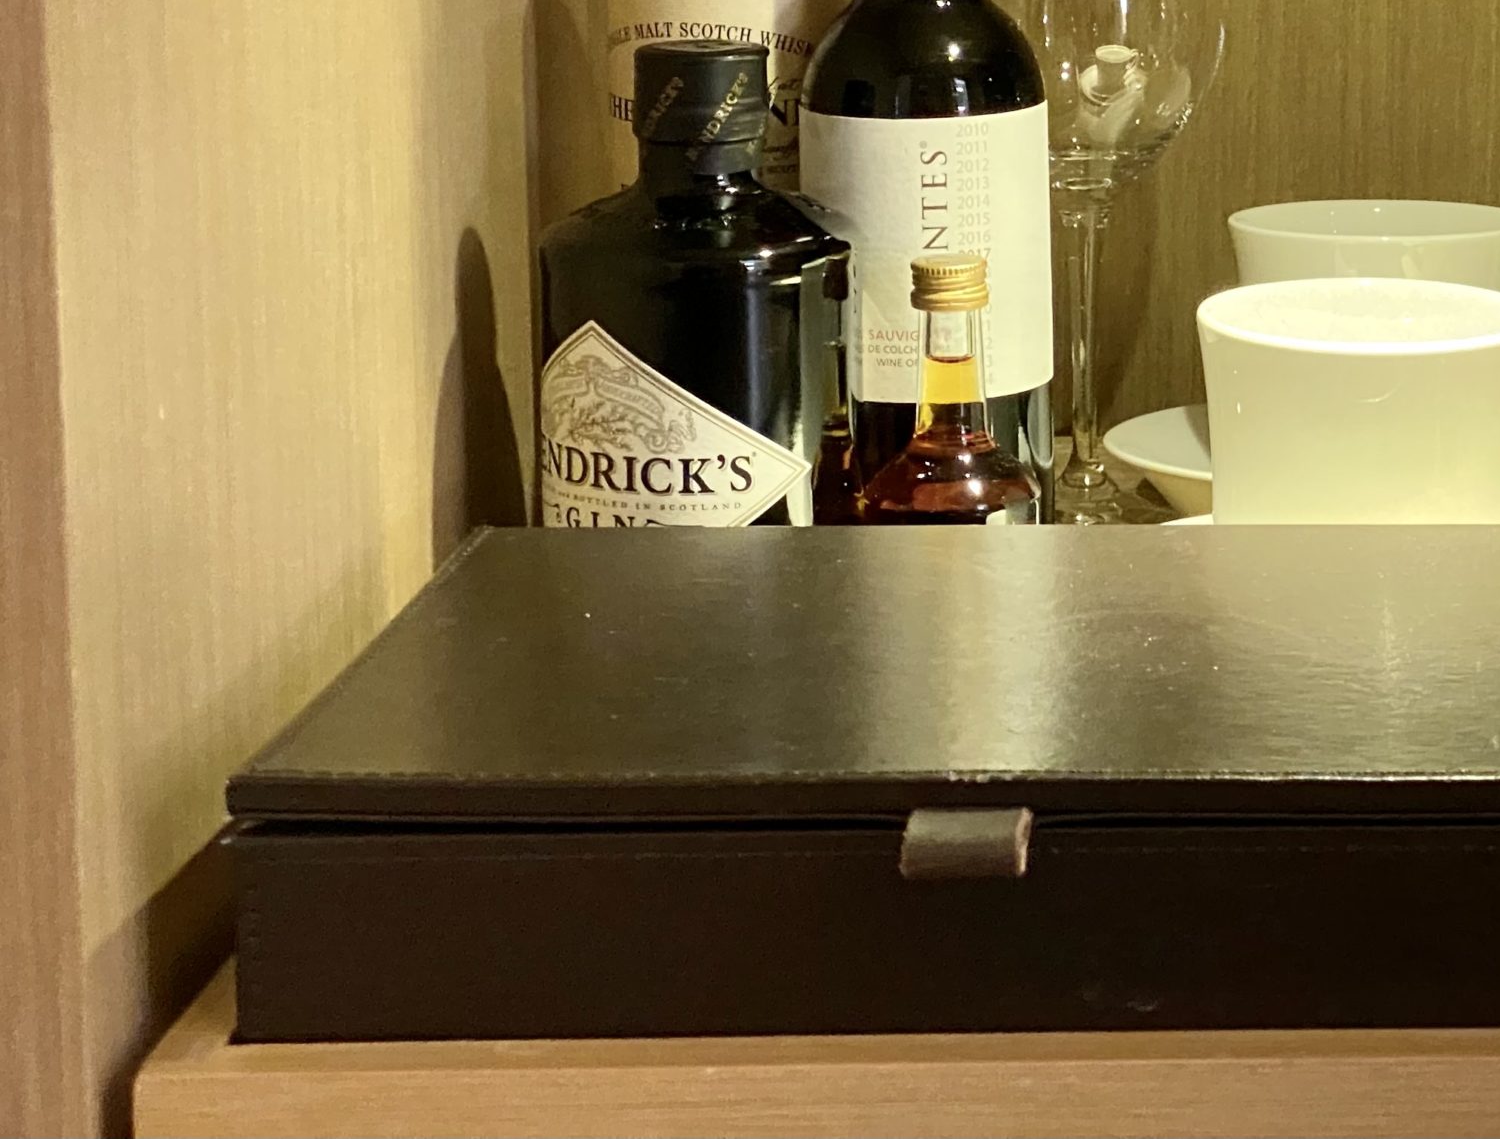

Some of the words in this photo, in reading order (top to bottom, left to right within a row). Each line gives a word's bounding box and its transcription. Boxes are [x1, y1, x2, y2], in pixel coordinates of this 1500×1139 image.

[634, 21, 673, 39] MALT
[679, 22, 752, 42] SCOTCH
[955, 122, 989, 137] 2010
[956, 140, 988, 155] 2011
[956, 158, 989, 174] 2012
[956, 176, 990, 192] 2013
[919, 149, 949, 250] NTES
[957, 194, 990, 210] 2014
[958, 212, 991, 228] 2015
[958, 230, 991, 246] 2016
[868, 329, 918, 342] SAUVIG
[868, 344, 880, 354] DE
[876, 357, 903, 368] WINE
[541, 438, 752, 494] NDRICK'S
[573, 493, 628, 509] BOTTLED
[635, 501, 651, 511] IN
[659, 502, 743, 511] SCOTLAND
